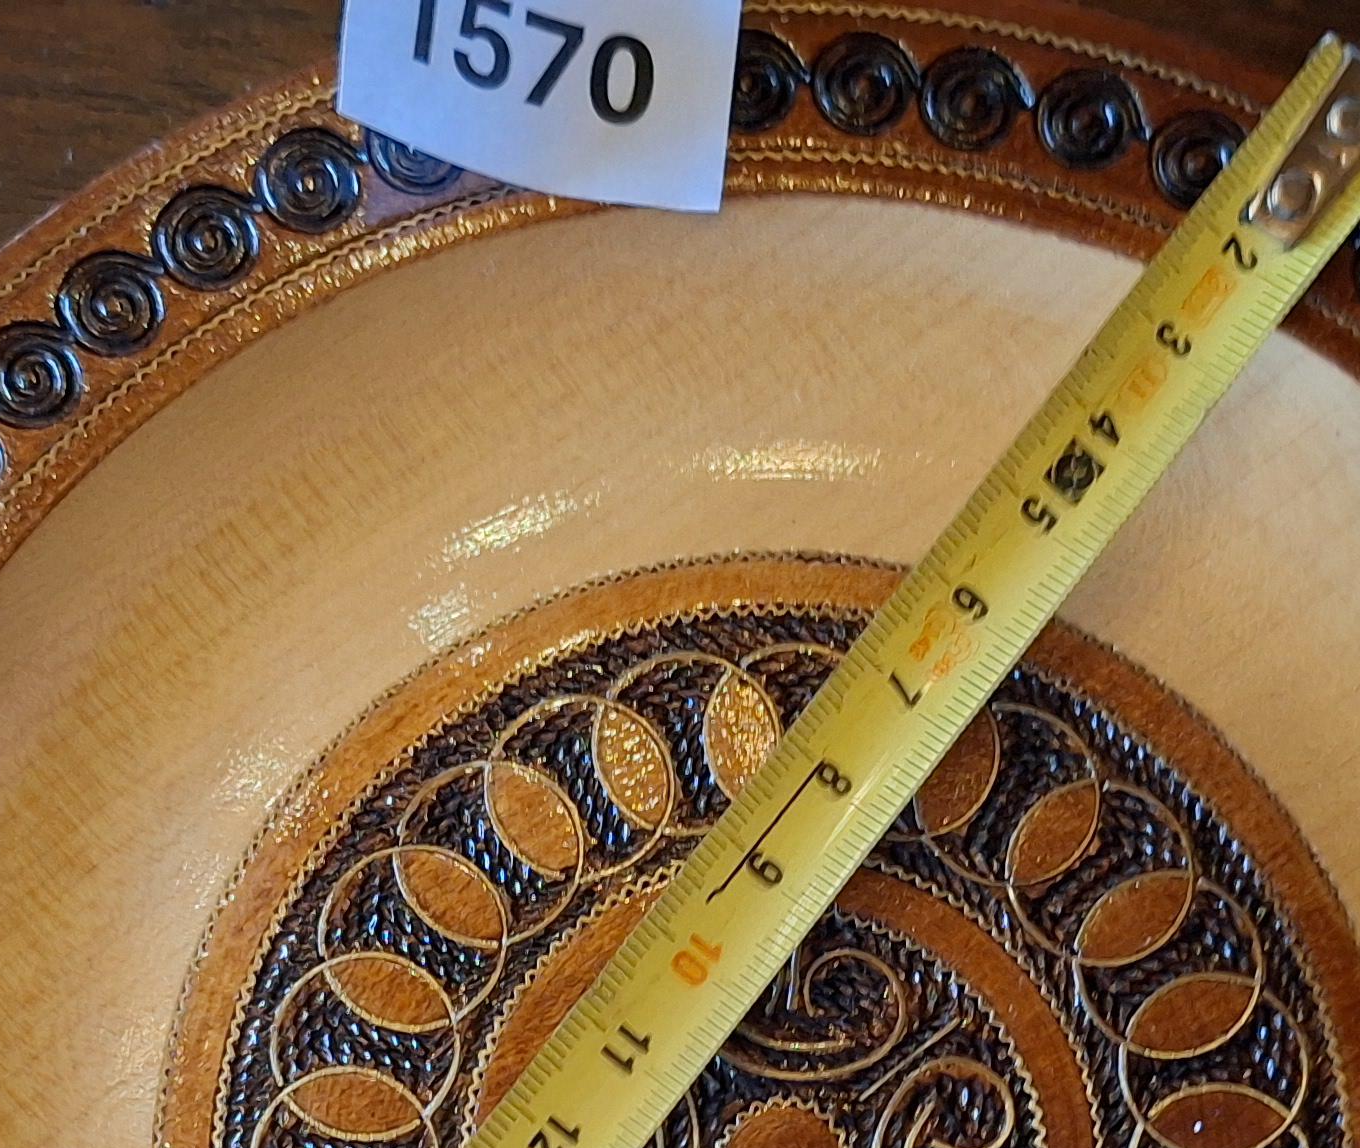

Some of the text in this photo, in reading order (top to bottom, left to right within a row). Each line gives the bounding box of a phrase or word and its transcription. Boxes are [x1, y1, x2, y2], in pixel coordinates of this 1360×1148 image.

[412, 0, 654, 125] 1570
[1222, 233, 1258, 270] 2
[1156, 321, 1192, 357] 3
[1088, 411, 1120, 446] 4
[1021, 496, 1059, 534] 5
[952, 585, 989, 621] 6
[889, 670, 923, 709] 7
[816, 761, 852, 796] 8
[747, 851, 783, 885] 9
[671, 932, 723, 987] 10
[601, 1024, 651, 1075] 11
